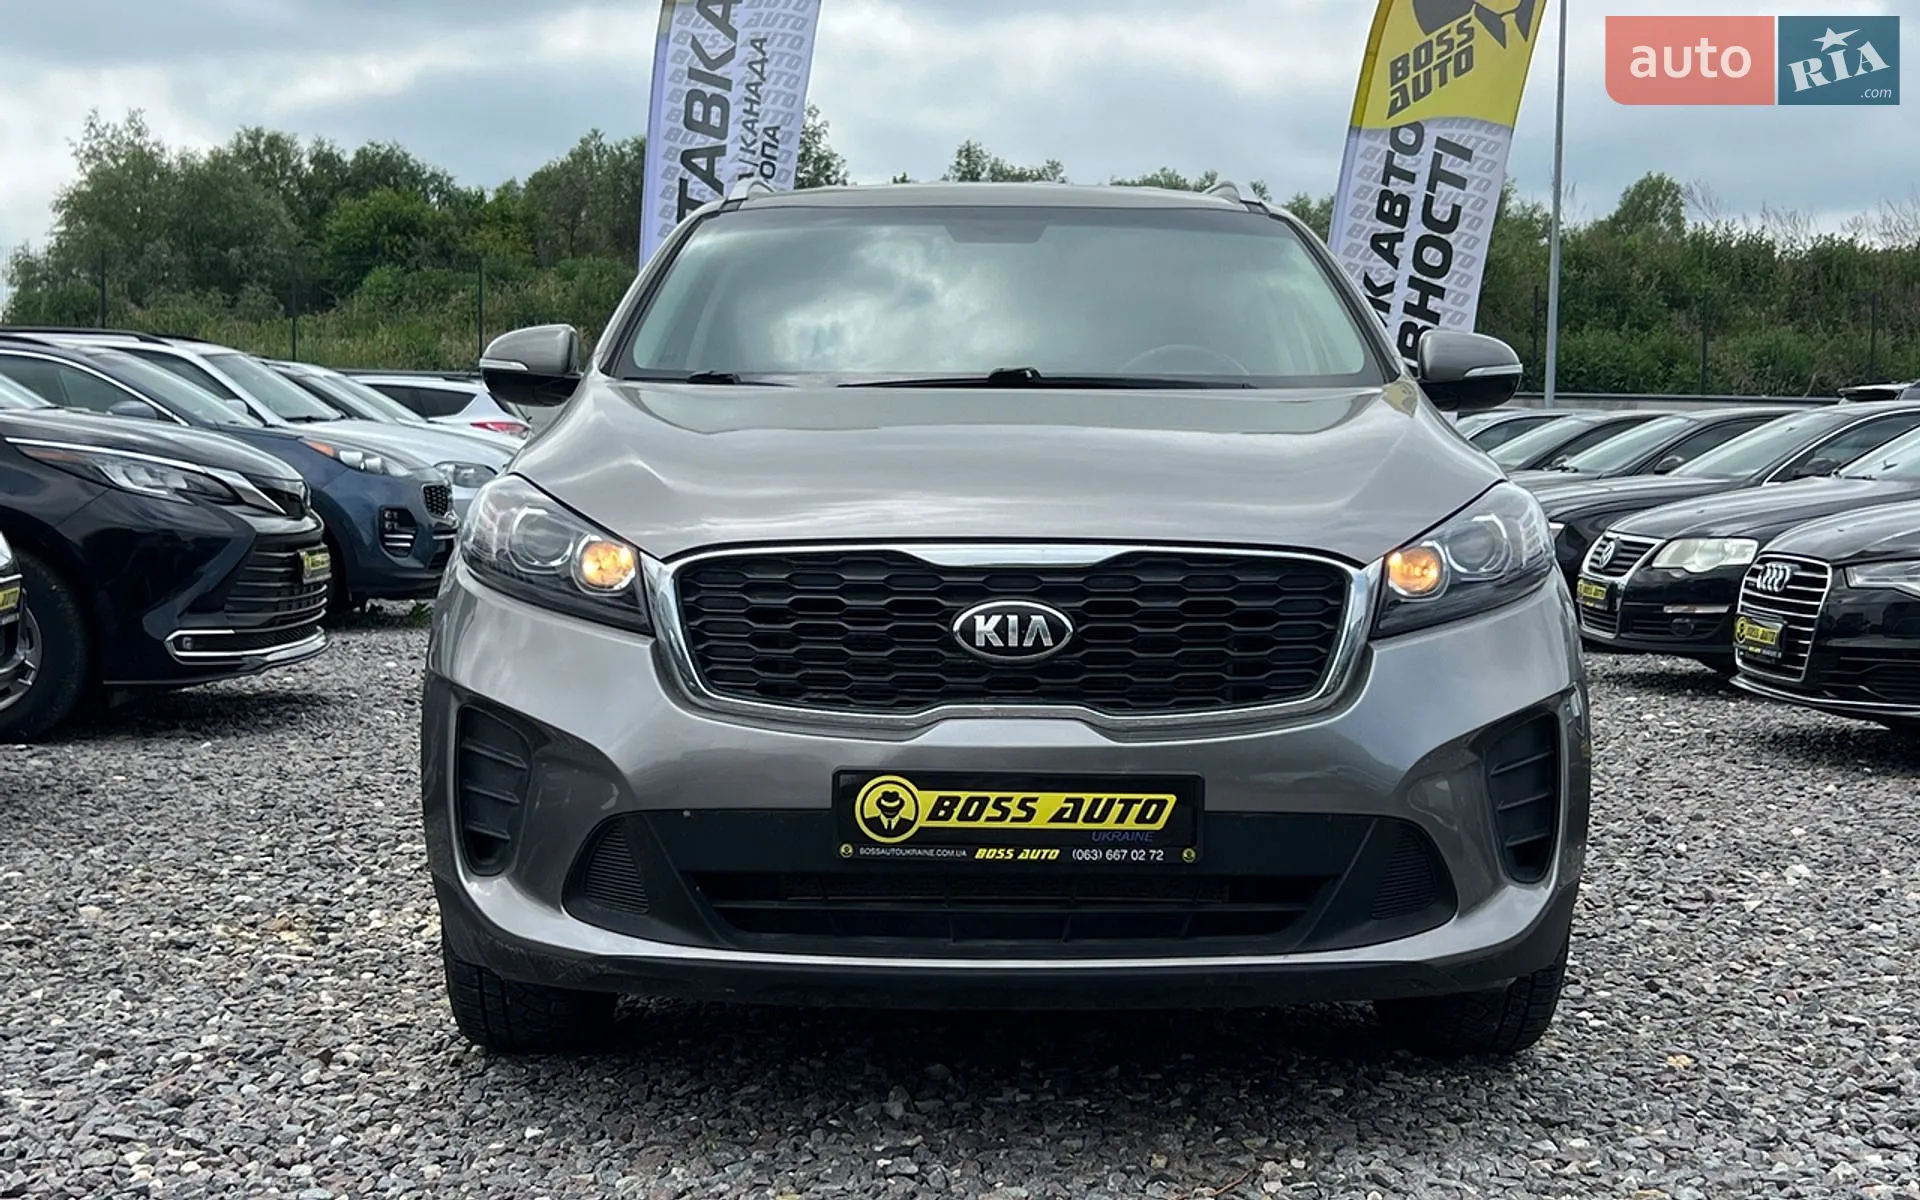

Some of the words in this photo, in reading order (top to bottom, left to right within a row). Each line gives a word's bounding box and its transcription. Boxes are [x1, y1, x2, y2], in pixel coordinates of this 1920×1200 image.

[1390, 17, 1475, 88] BOSS
[1387, 45, 1474, 120] AUTO
[760, 126, 781, 181] ОПА
[1370, 121, 1425, 270] АВТО
[1397, 136, 1474, 363] ВНОСТІ
[974, 615, 1053, 647] KIA
[925, 795, 1039, 823] BOSS
[1046, 797, 1171, 824] AUTO
[1092, 831, 1153, 842] UKRAINE
[974, 848, 1014, 860] BOSS
[1017, 848, 1060, 860] AUTO
[1072, 849, 1102, 861] (063)
[1105, 850, 1127, 861] 667
[1131, 850, 1146, 861] 02
[1149, 850, 1164, 861] 72
